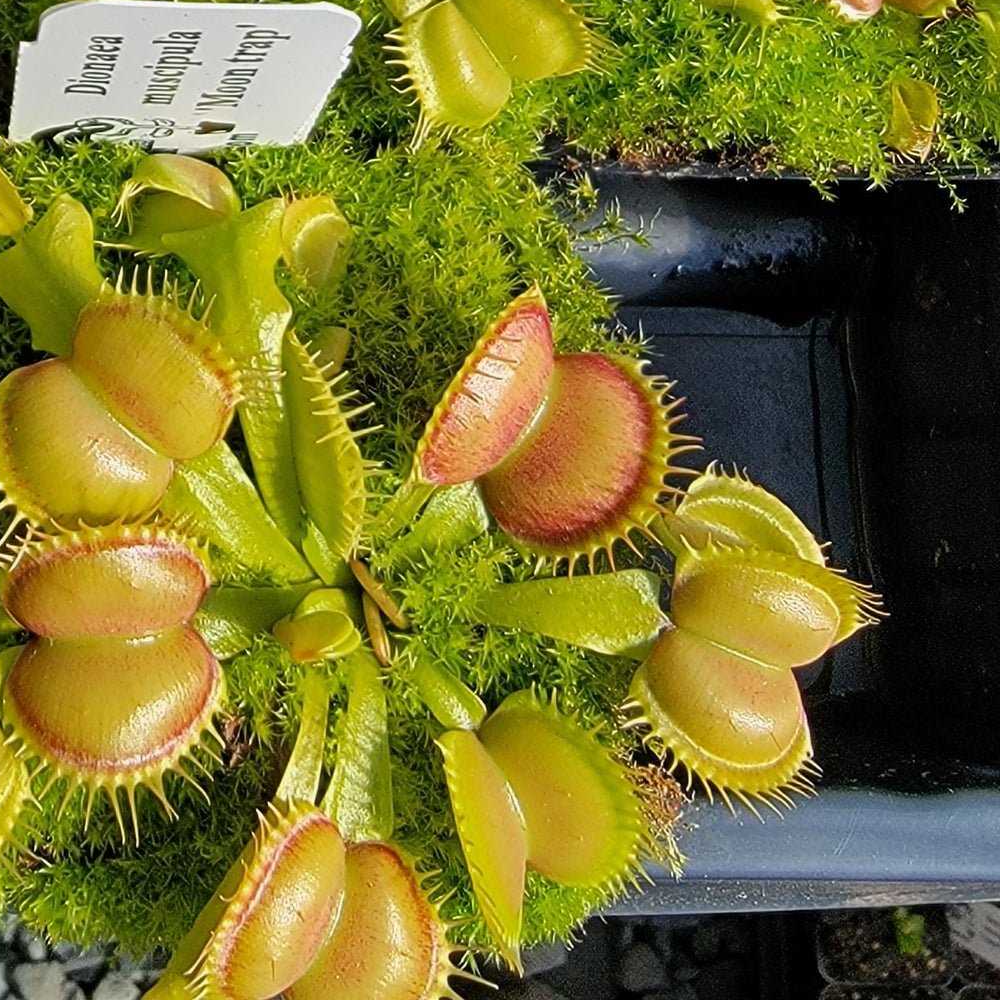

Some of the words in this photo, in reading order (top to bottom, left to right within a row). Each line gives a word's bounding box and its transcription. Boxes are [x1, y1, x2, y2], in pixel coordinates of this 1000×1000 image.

[64, 36, 124, 96] Dionaea
[142, 31, 202, 105] muscipula
[224, 24, 291, 68] trap'
